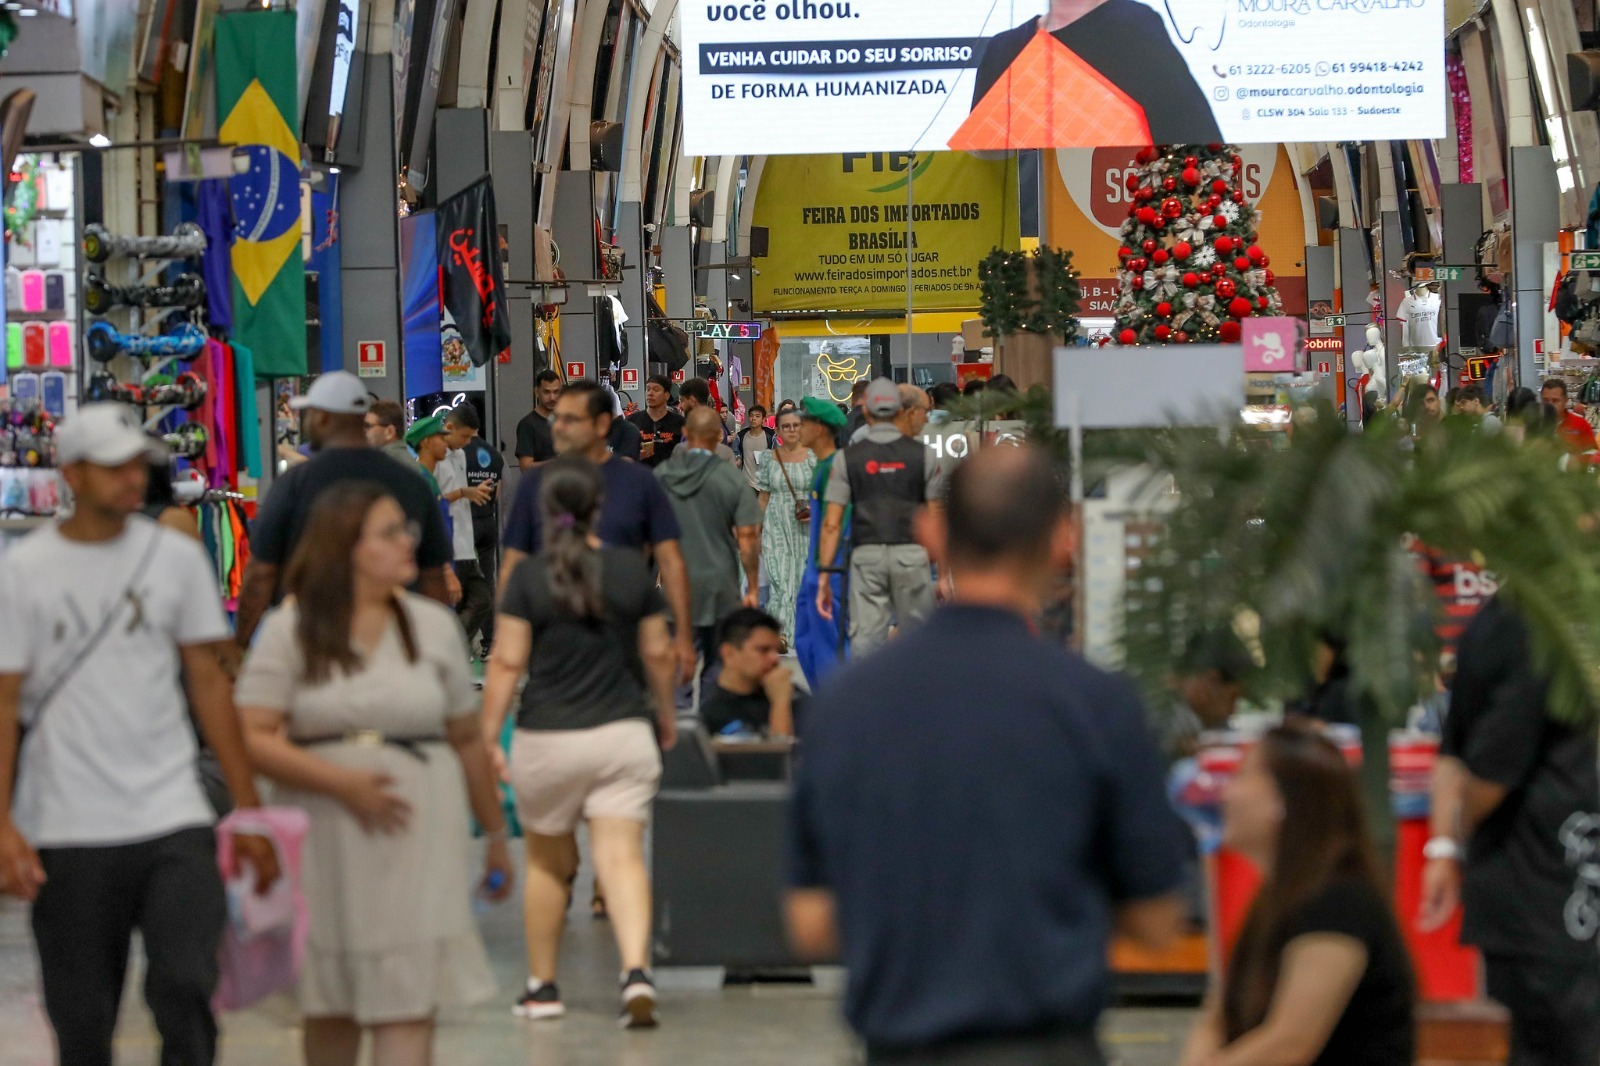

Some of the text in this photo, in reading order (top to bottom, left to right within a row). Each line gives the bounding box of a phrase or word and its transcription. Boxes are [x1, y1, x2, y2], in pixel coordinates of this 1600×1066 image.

[706, 0, 860, 21] você olhou.
[1238, 0, 1311, 15] MOURA
[1238, 18, 1296, 29] Odontologia
[707, 46, 972, 67] VENHA CUIDAR DO SEU SORRISO
[1229, 60, 1424, 76] 61 3222-6205 61 99418-4242
[711, 79, 947, 99] DE FORMA HUMANIZADA
[1236, 82, 1424, 100] @mouracarvalho.odontologia
[1257, 108, 1284, 117] CLSW
[1287, 108, 1305, 117] 304
[1357, 106, 1401, 115] Sudoeste
[802, 203, 980, 224] FEIRA DOS IMPORTADOS
[848, 227, 918, 250] BRASÍLIA
[818, 254, 847, 265] TUDO
[850, 254, 865, 264] EM
[868, 253, 884, 264] UM
[887, 251, 902, 263] SÓ
[794, 266, 972, 281] www.feiradosimportados.net.br
[773, 286, 838, 296] FUNCIONAMENTO:
[839, 286, 863, 295] TERÇA
[872, 284, 907, 293] DOMINGO
[915, 283, 952, 292] FERIADOS
[954, 283, 963, 291] DE
[1093, 287, 1101, 297] B
[740, 324, 749, 337] 5
